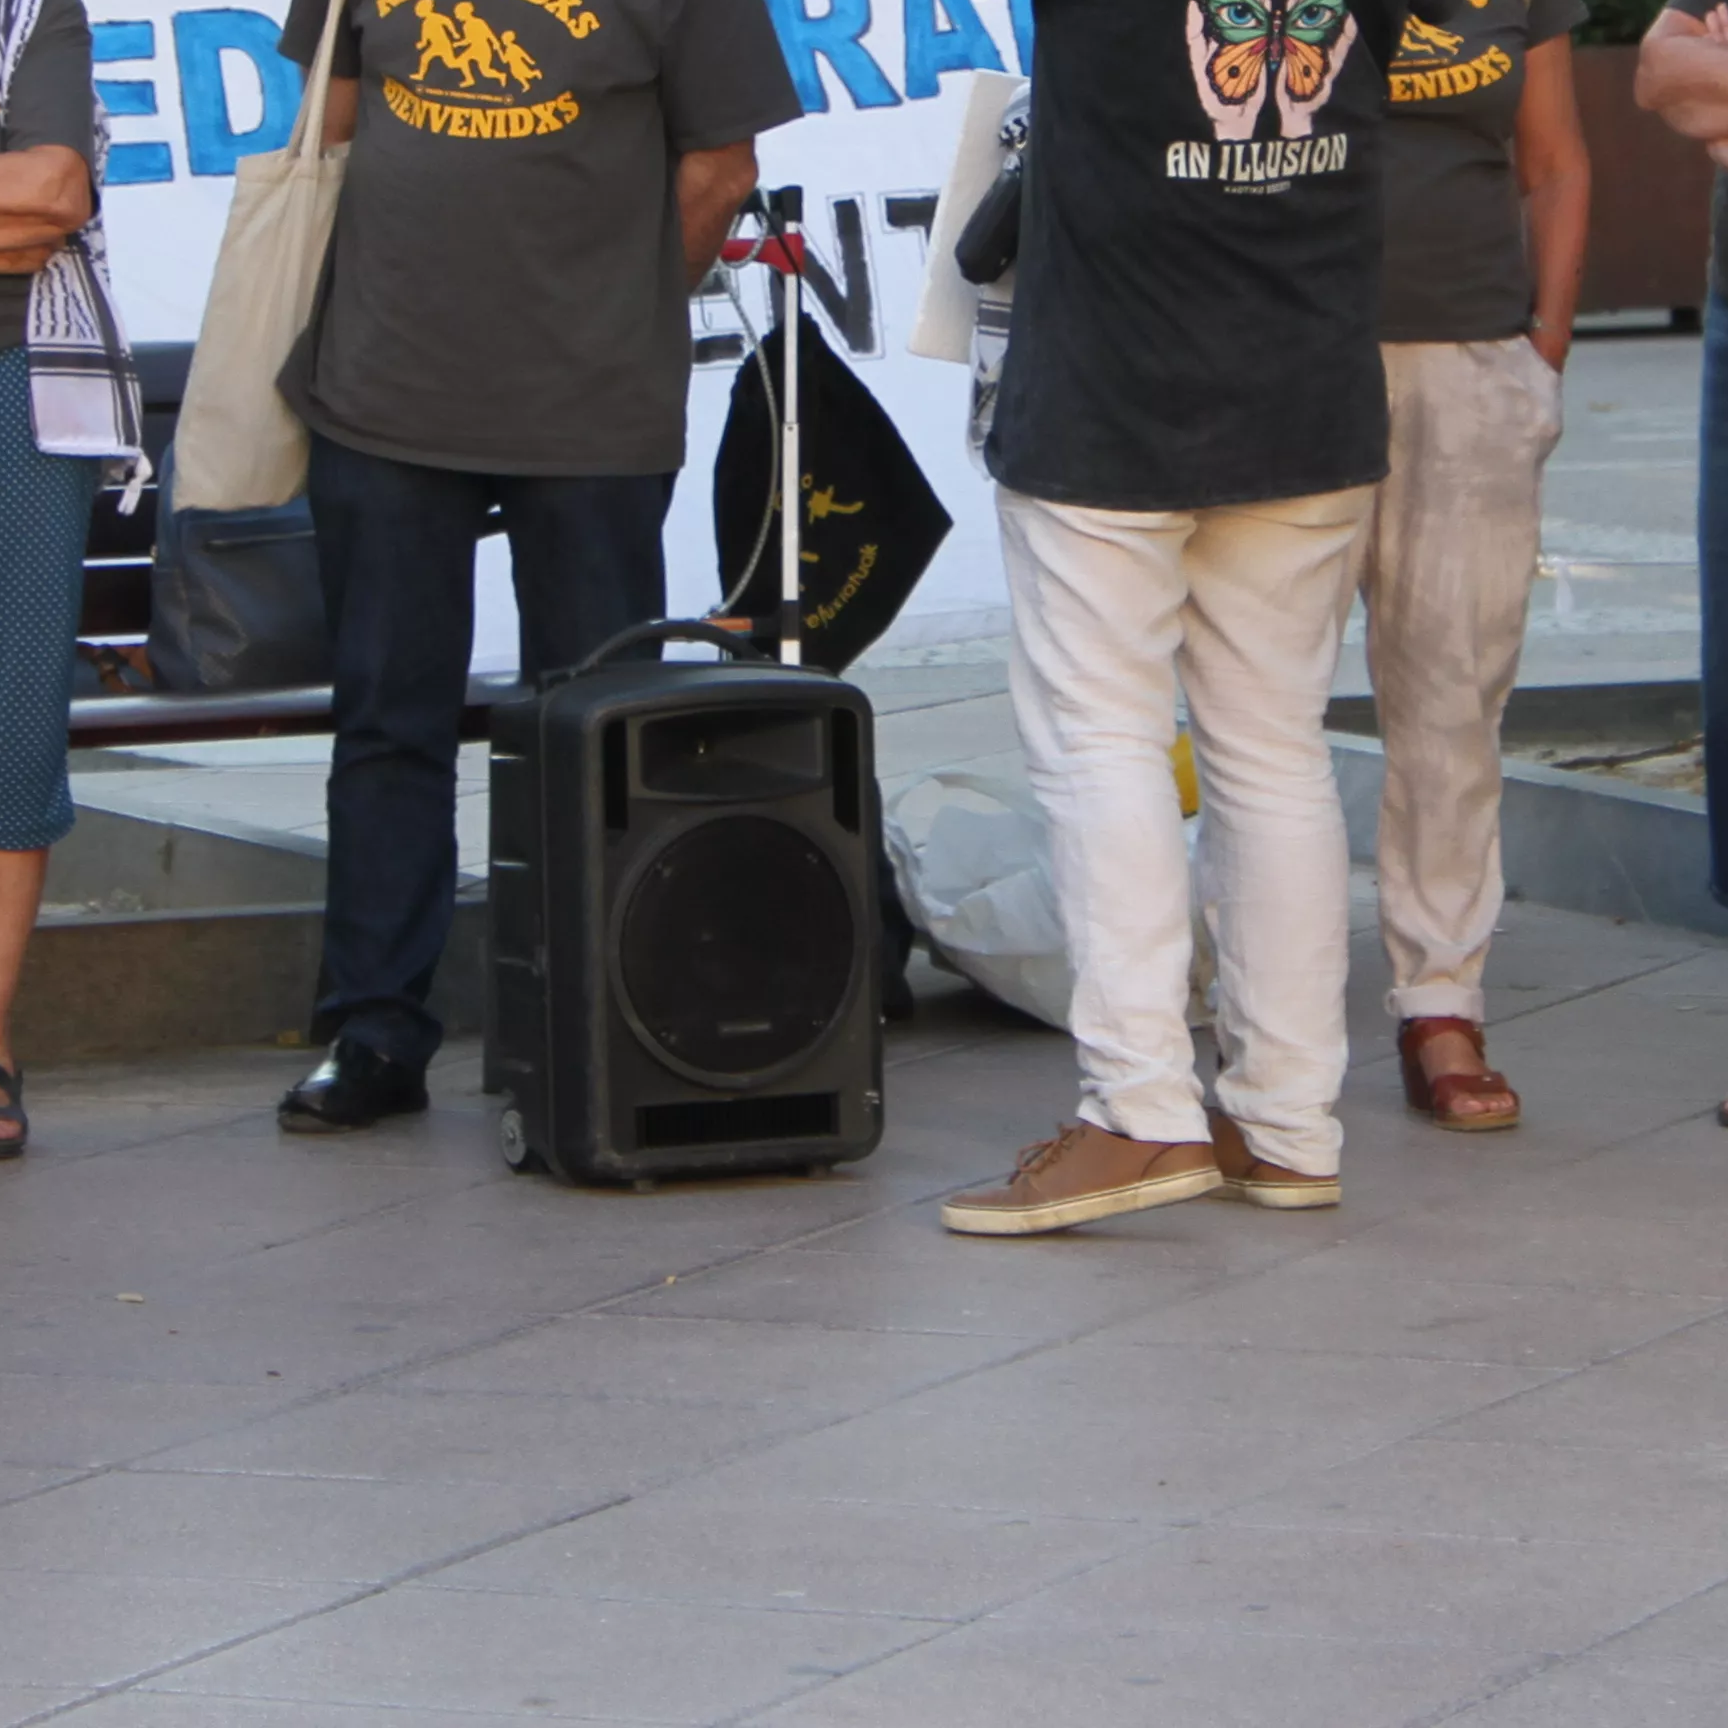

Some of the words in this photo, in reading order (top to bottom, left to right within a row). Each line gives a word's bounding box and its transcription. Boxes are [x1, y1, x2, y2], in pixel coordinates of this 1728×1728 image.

[382, 75, 581, 140] BIENVENIDXS
[1167, 140, 1211, 179] AN
[1217, 132, 1348, 182] ILLUSION
